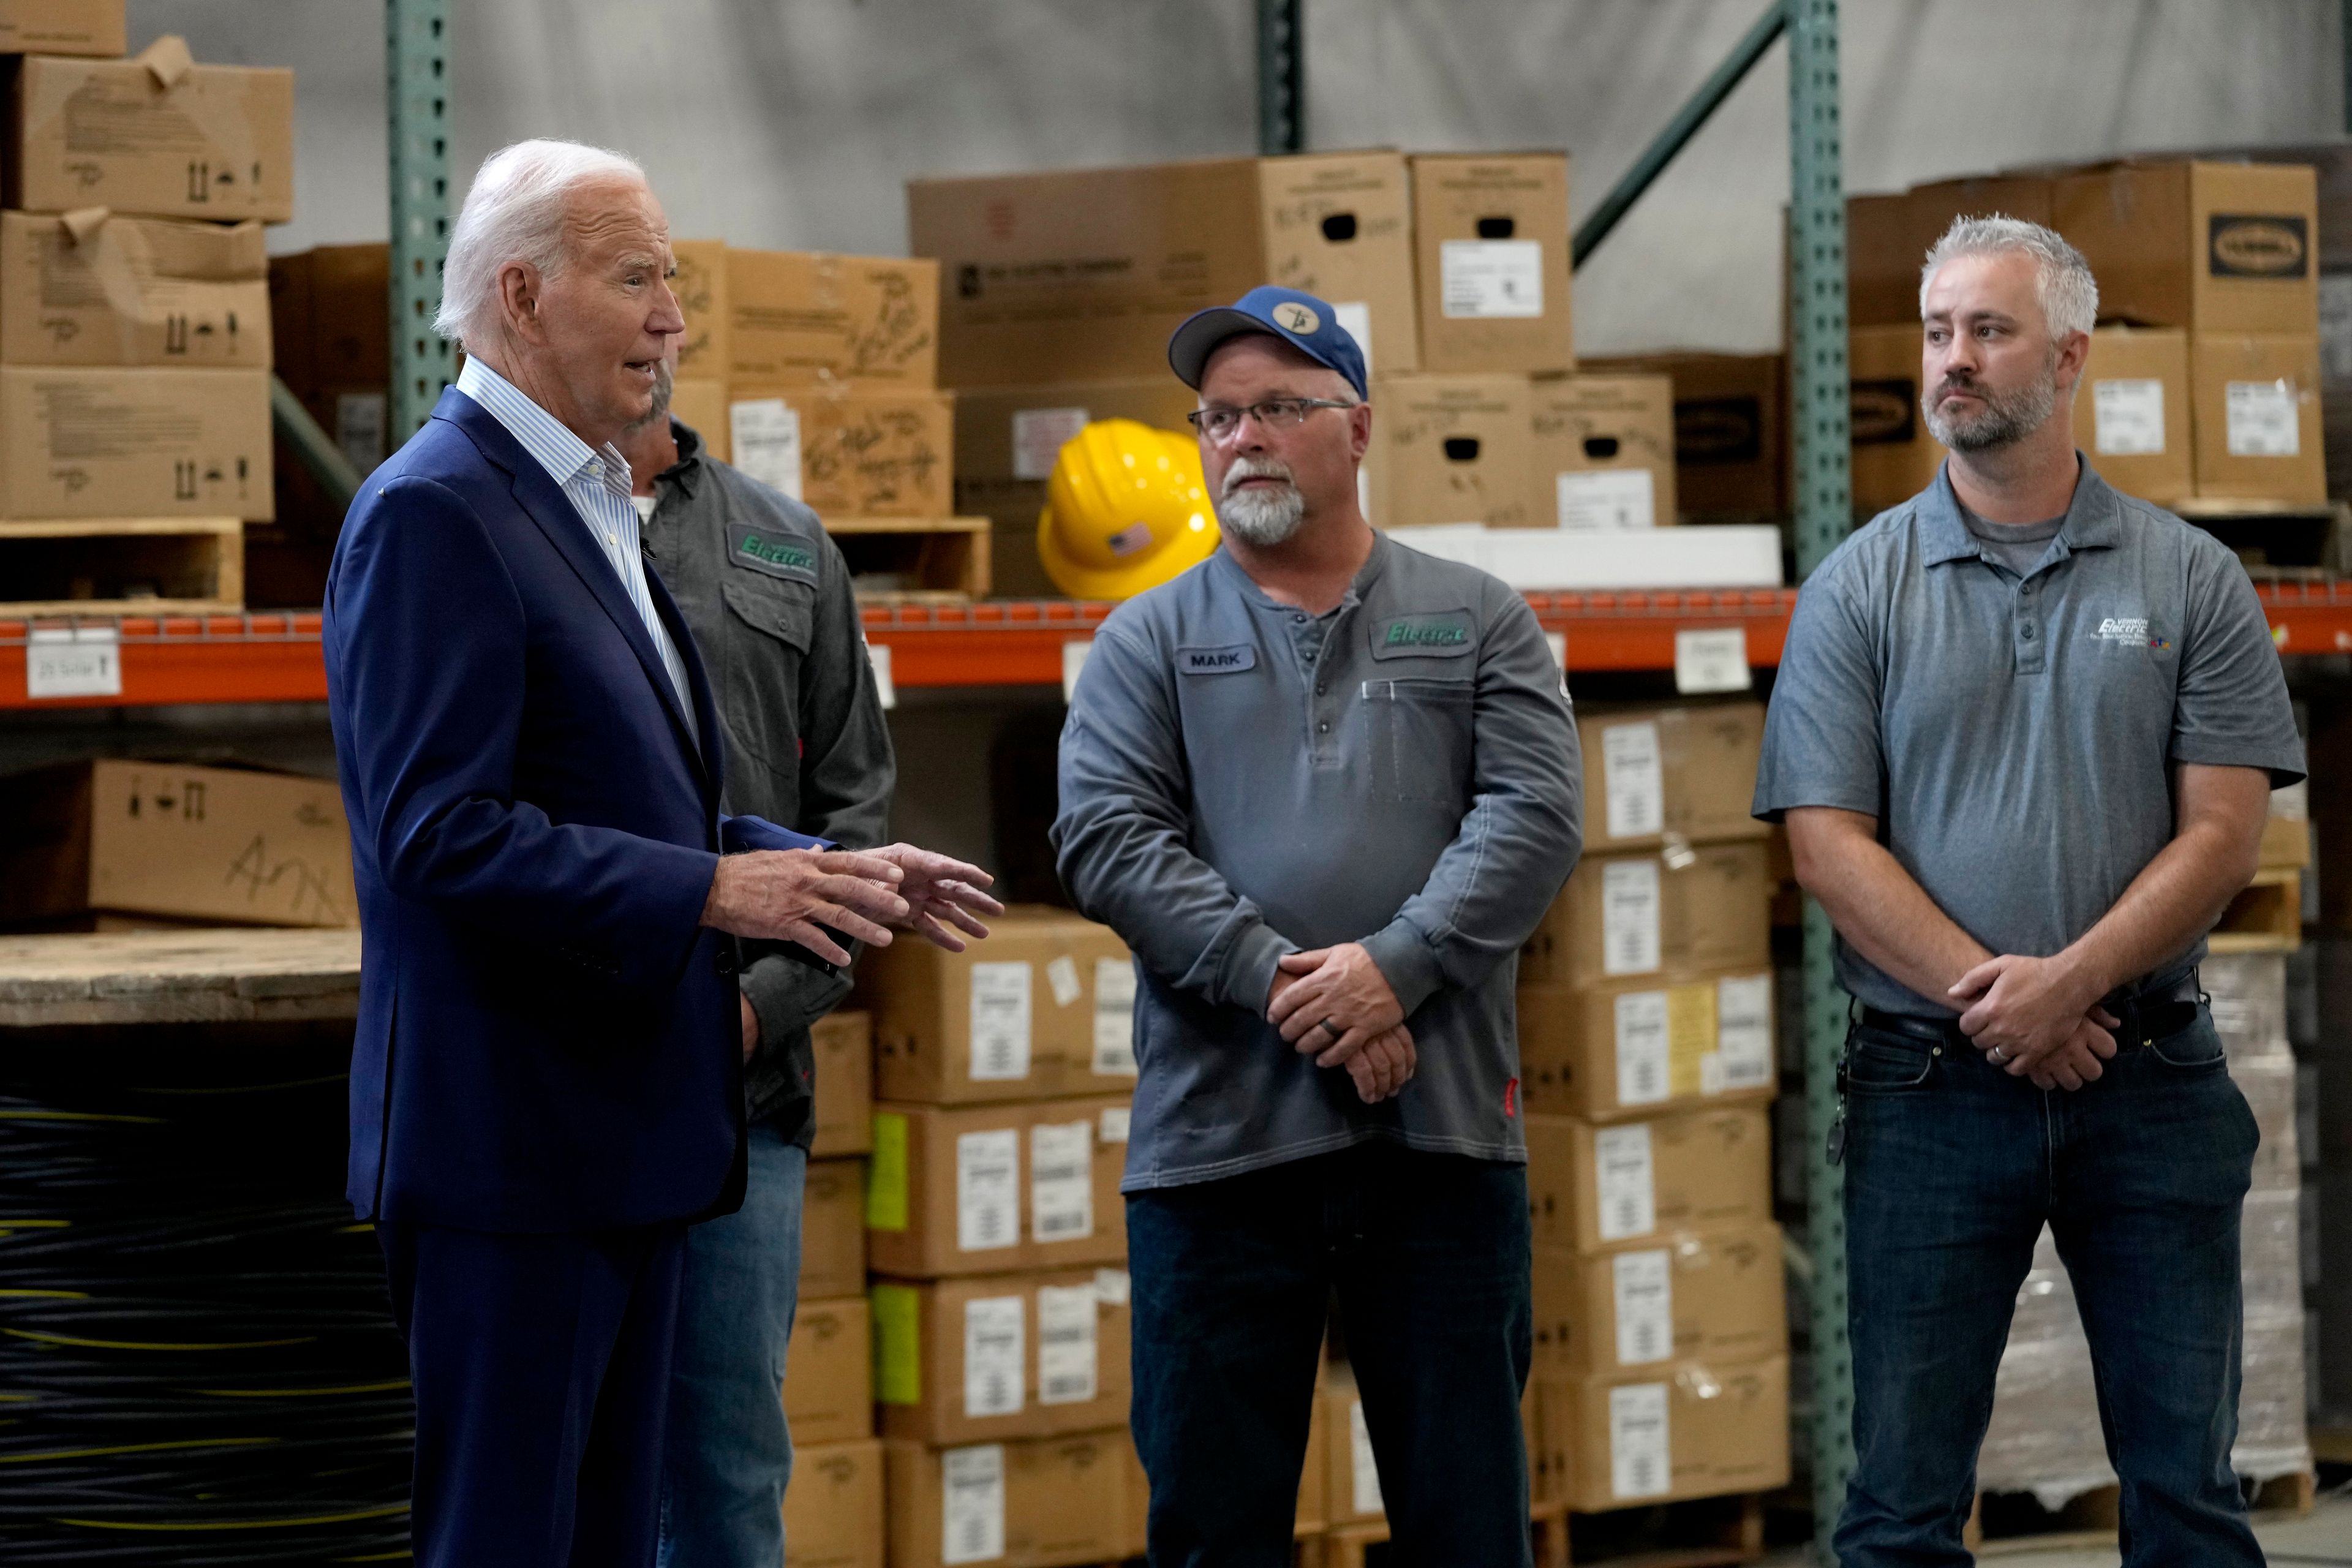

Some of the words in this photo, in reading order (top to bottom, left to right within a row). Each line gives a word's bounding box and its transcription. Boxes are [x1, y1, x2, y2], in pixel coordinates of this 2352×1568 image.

[2098, 617, 2148, 633] Electric
[2117, 617, 2148, 625] VERNON
[1191, 652, 1240, 667] MARK
